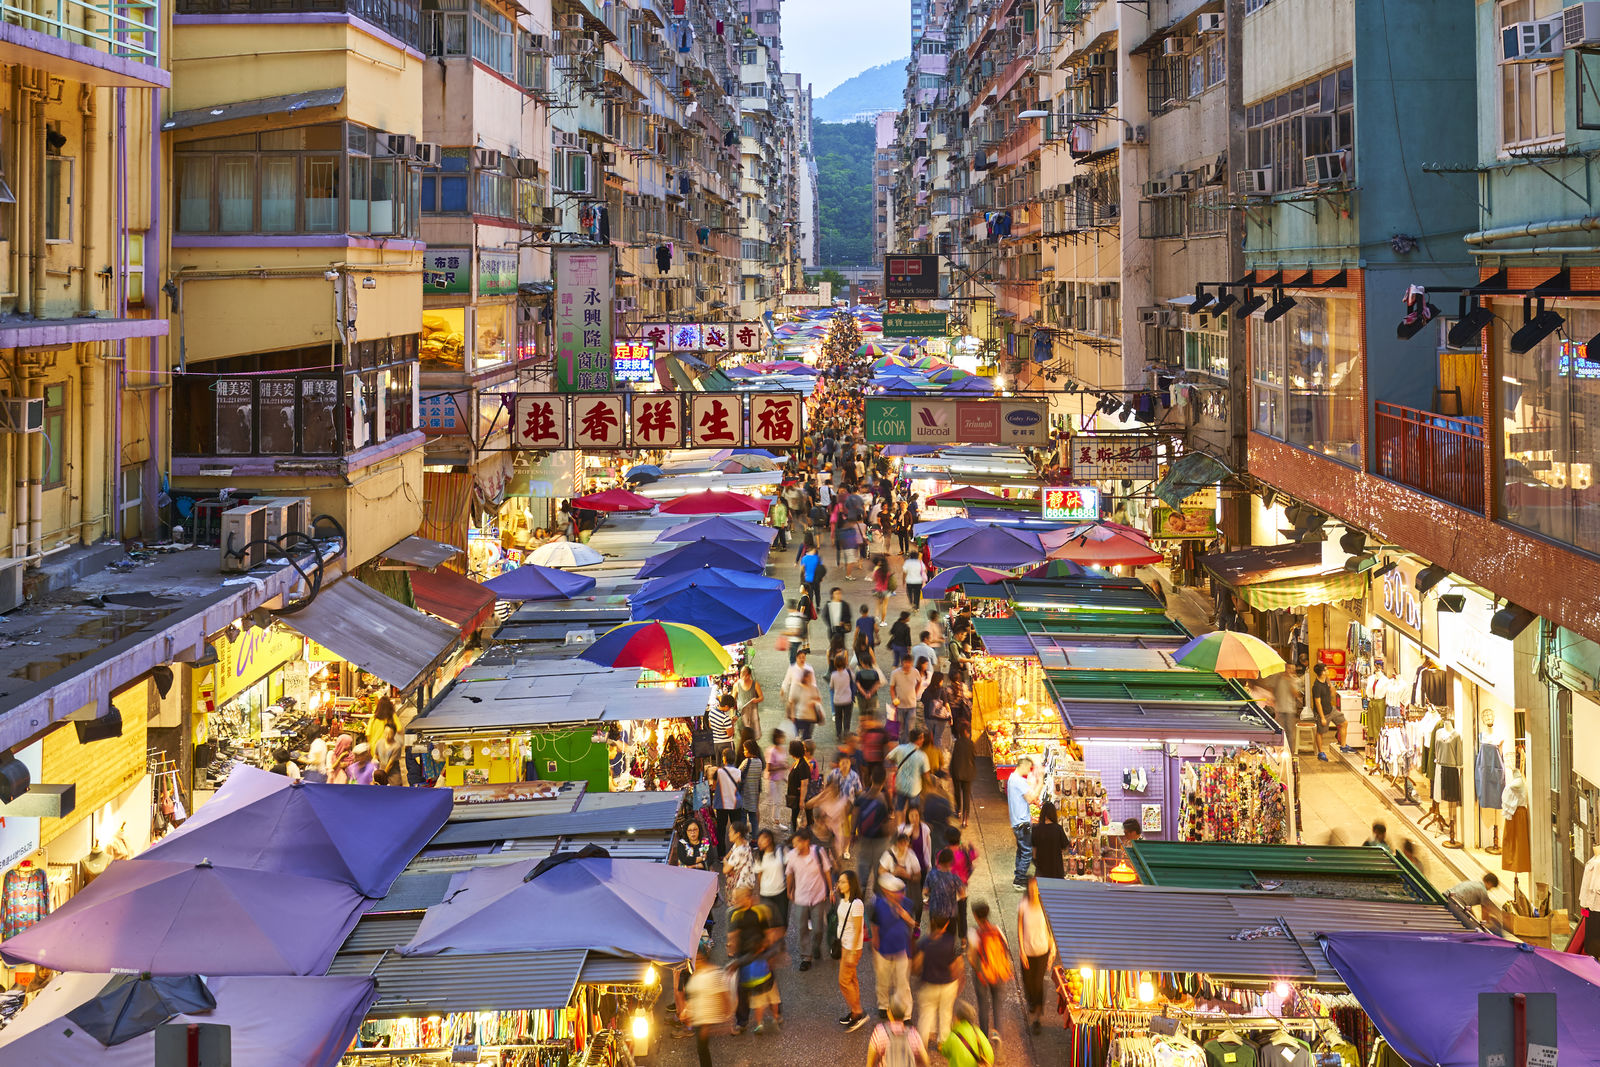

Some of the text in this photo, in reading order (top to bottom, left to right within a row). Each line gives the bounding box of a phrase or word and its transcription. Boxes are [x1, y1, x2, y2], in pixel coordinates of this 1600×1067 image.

[584, 287, 601, 347] 永興隆
[965, 419, 992, 429] Triumph
[917, 428, 949, 436] Wacoal
